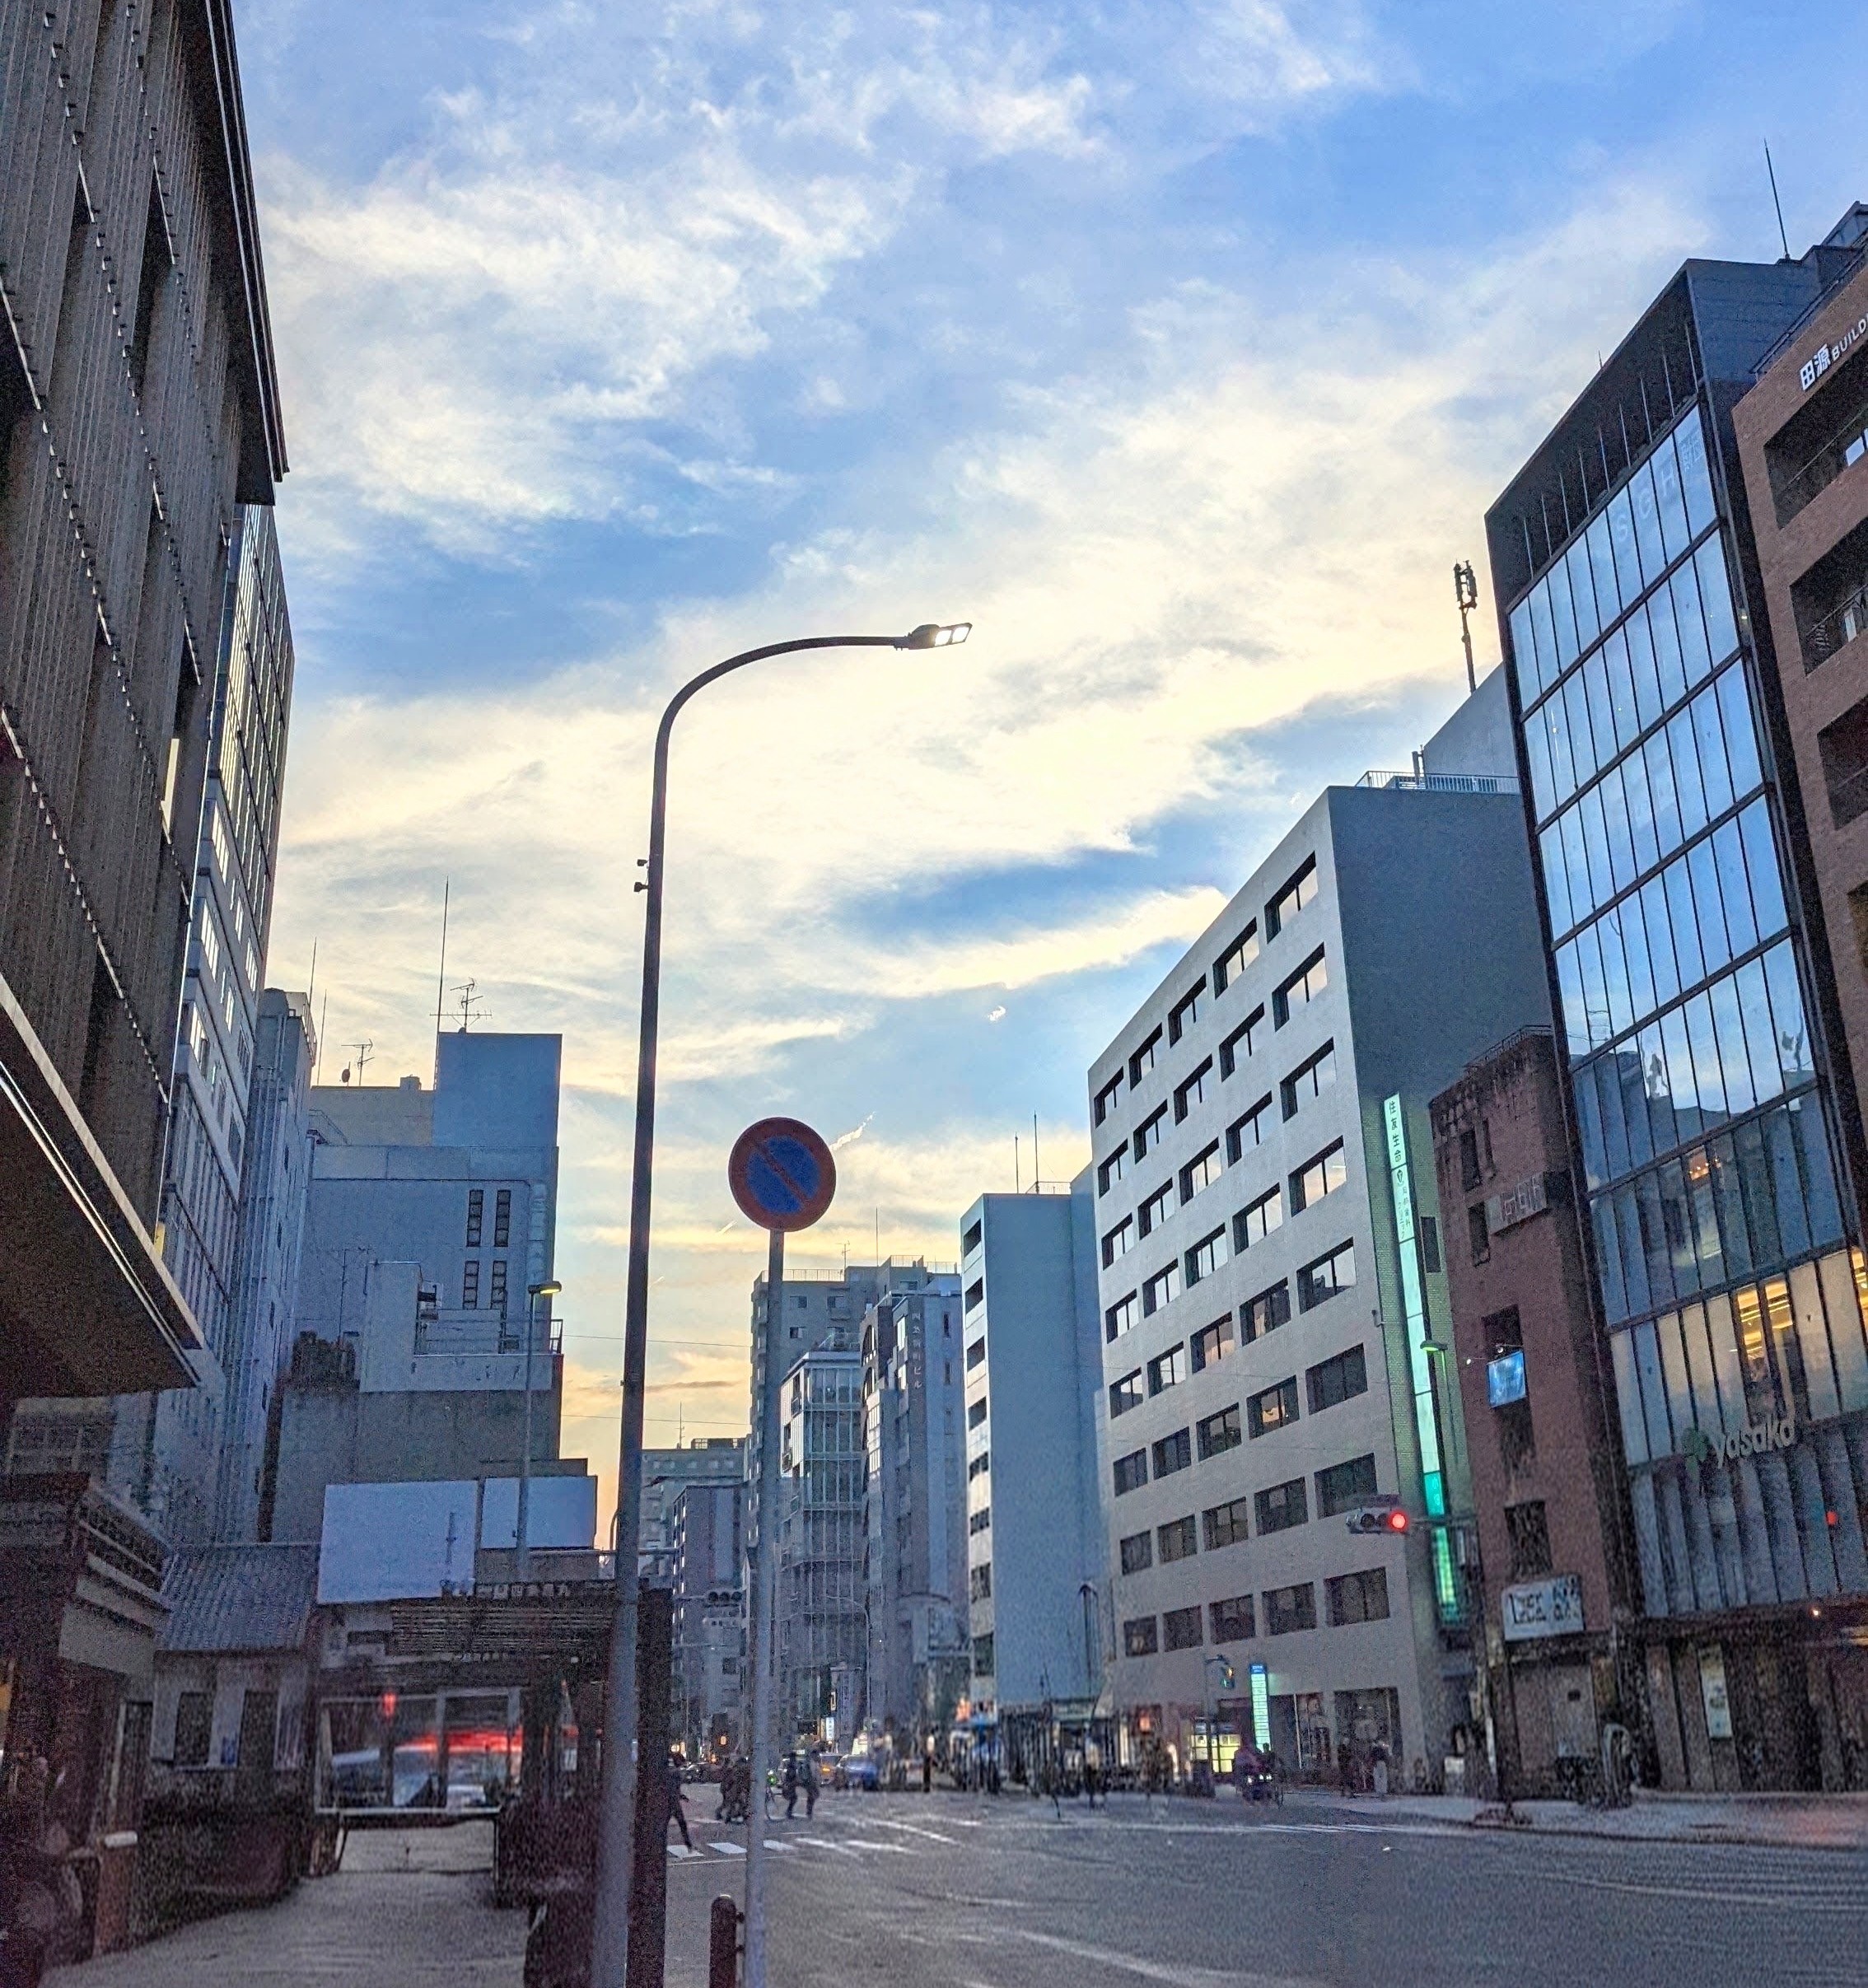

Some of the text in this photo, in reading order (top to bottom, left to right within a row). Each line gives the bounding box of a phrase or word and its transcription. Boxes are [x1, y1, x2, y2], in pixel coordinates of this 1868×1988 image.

[1800, 343, 1831, 390] 田源
[1389, 1100, 1402, 1163] 住友生命
